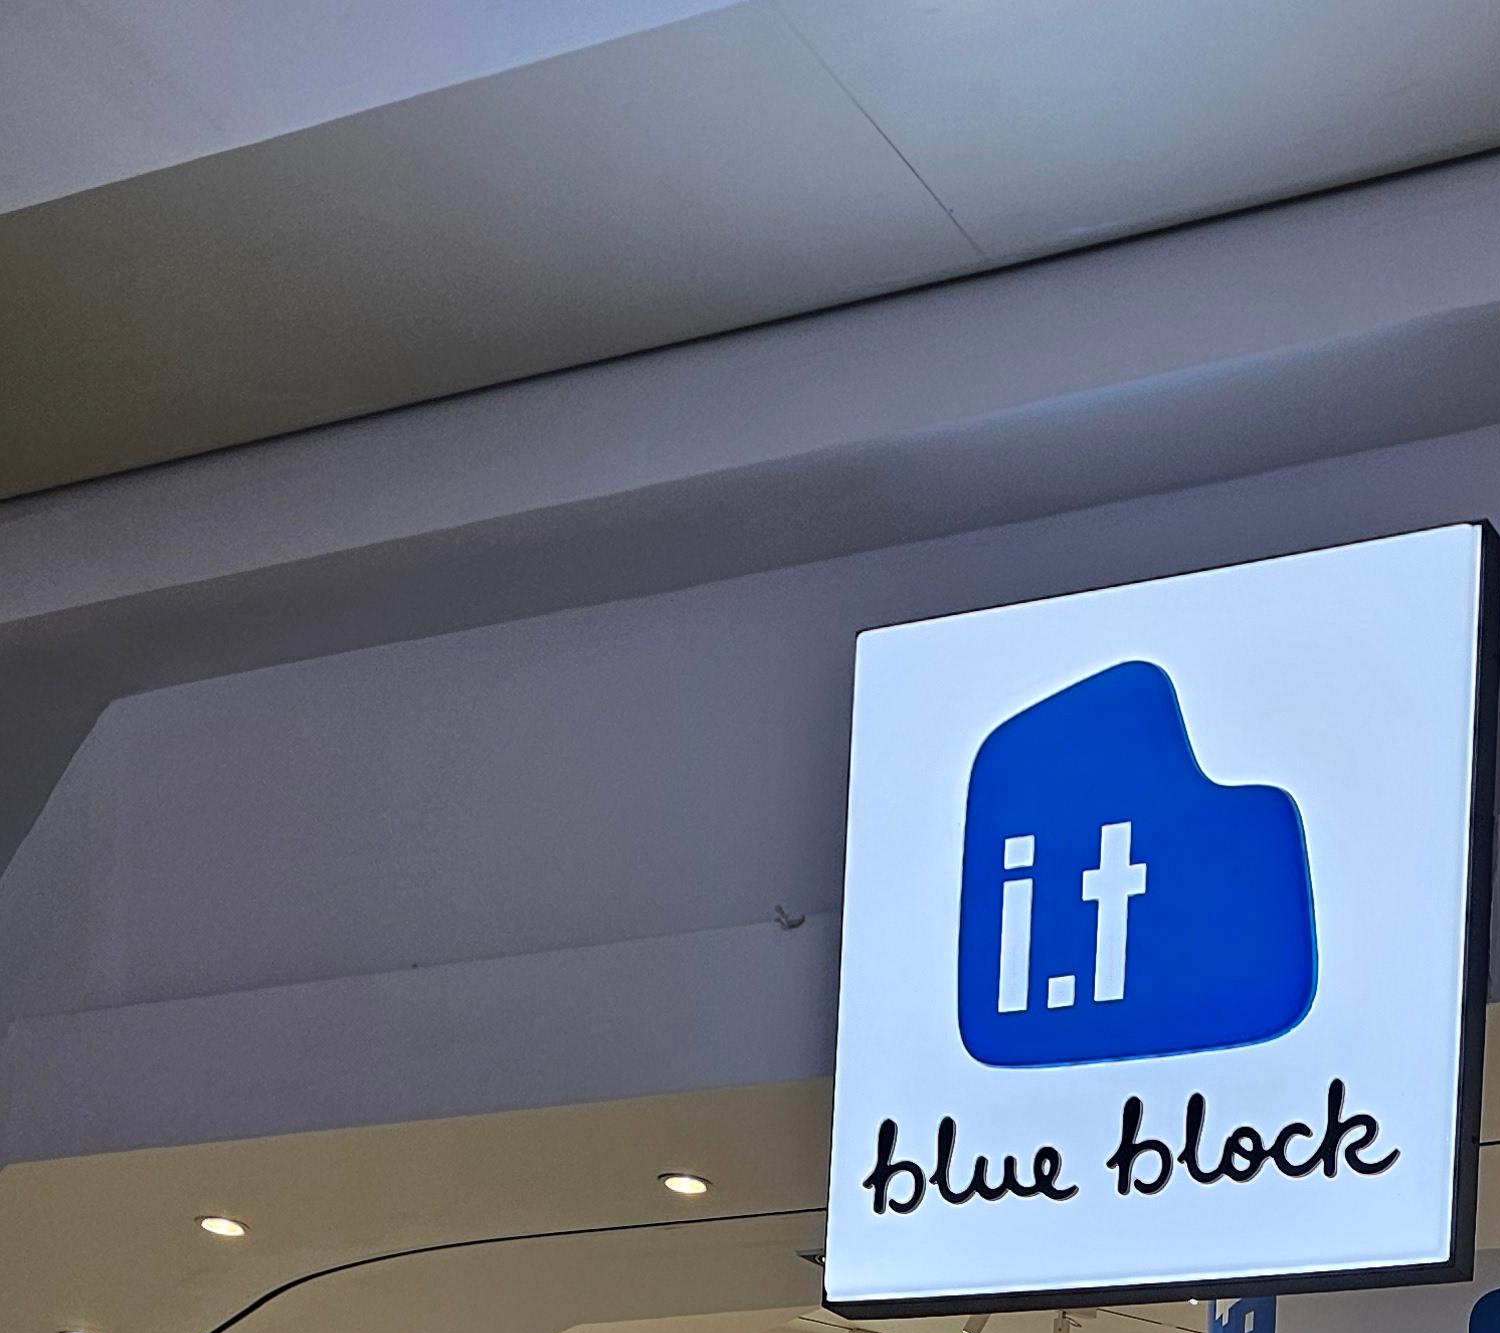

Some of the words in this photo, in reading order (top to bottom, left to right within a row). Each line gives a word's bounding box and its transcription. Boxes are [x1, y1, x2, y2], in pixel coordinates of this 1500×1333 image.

[997, 822, 1147, 1013] i.t
[863, 1116, 1079, 1215] blue
[1106, 1077, 1401, 1195] block
